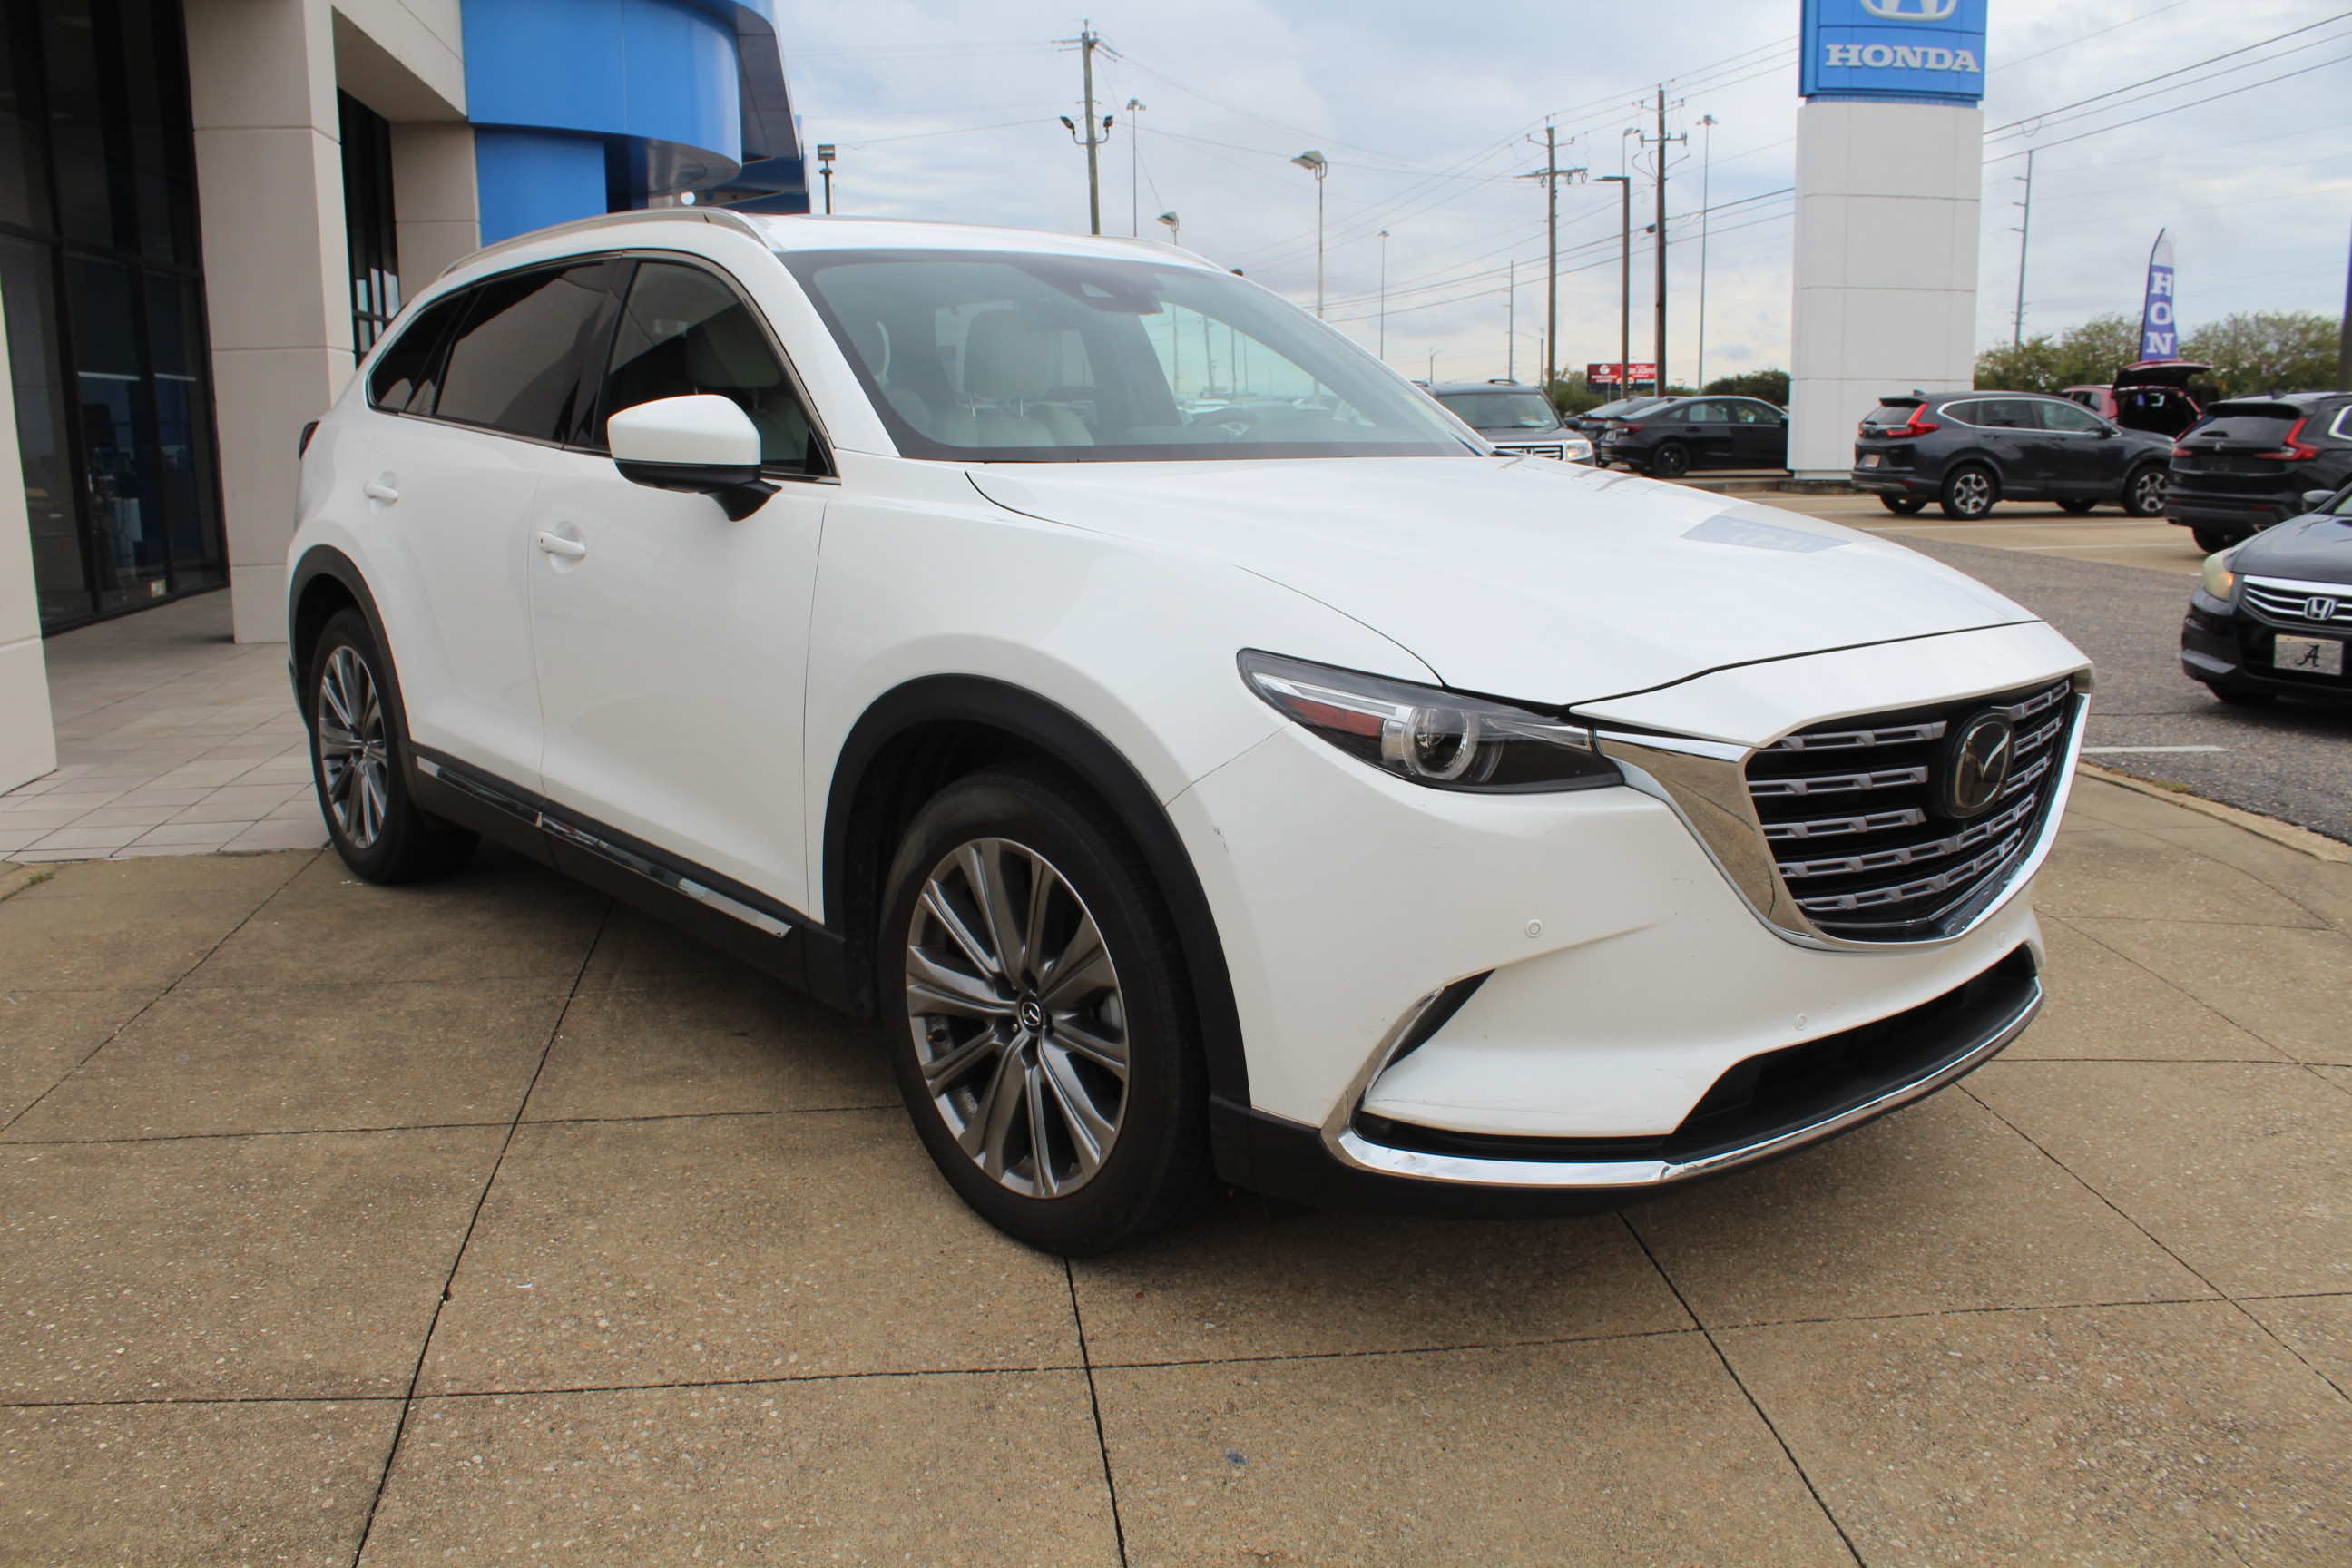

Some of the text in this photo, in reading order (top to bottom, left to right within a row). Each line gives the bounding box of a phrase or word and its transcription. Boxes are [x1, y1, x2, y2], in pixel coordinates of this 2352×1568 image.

[1825, 44, 1980, 72] HONDA
[2146, 272, 2175, 355] HON
[2294, 642, 2320, 668] A
